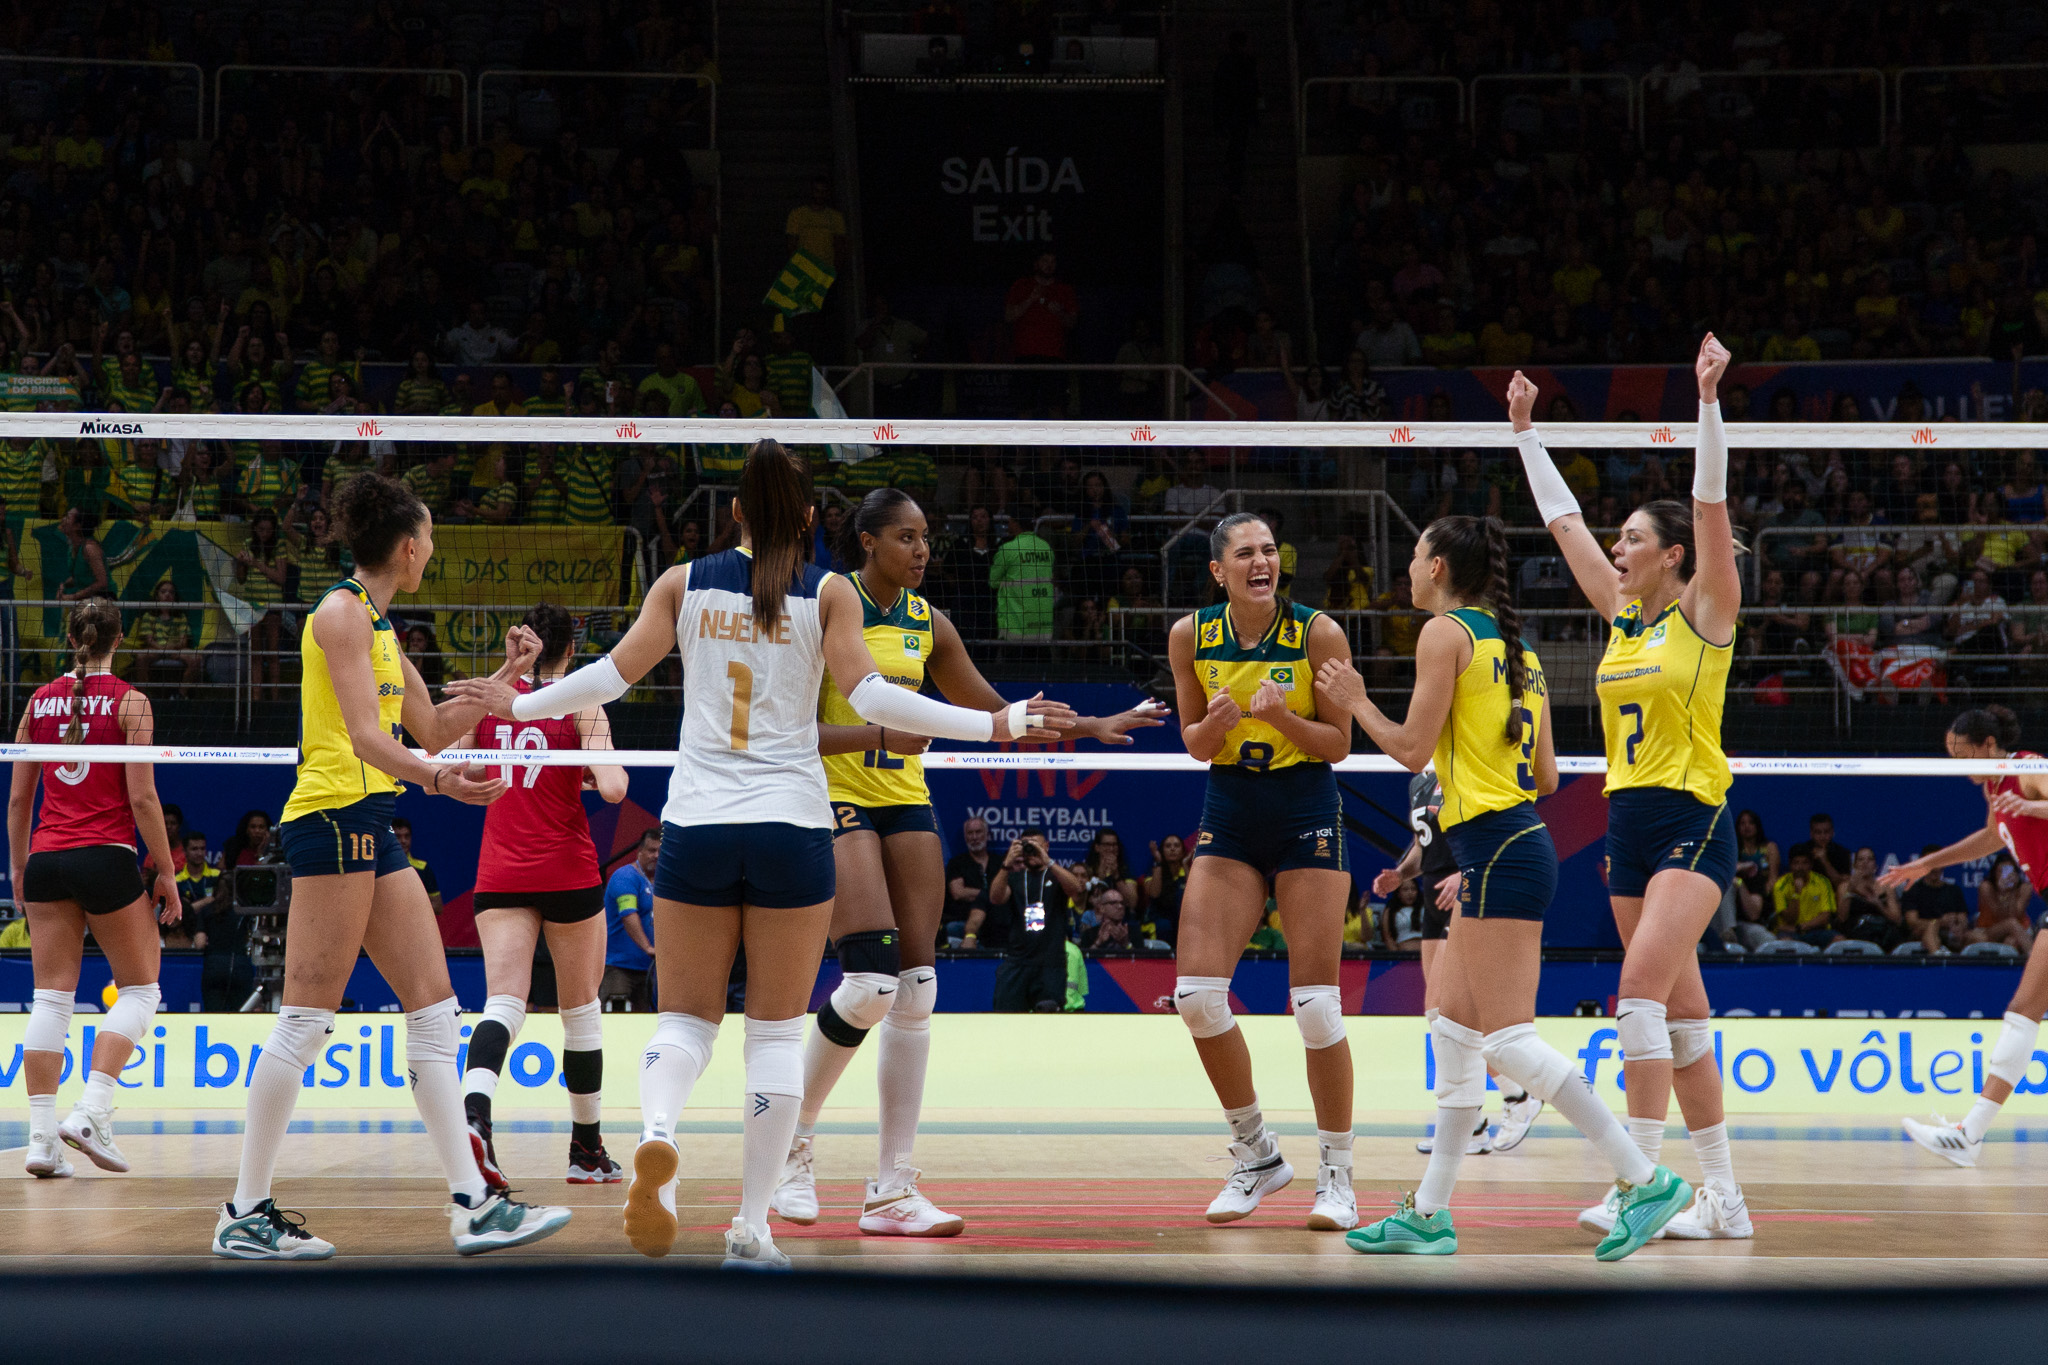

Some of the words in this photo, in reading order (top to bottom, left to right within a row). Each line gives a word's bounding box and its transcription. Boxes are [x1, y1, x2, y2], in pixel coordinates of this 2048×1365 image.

[941, 147, 1086, 194] SAÍDA
[972, 204, 1053, 242] Exit
[13, 377, 60, 385] TORCIDA
[13, 386, 29, 394] DO
[31, 386, 66, 395] BRASIL
[80, 418, 143, 434] MIKASA
[357, 420, 383, 436] VNL
[616, 422, 642, 438] VNL
[874, 423, 899, 440] VNL
[1131, 425, 1156, 442] VNL
[1390, 426, 1415, 443] VNL
[1651, 426, 1676, 443] VNL
[1911, 427, 1938, 444] VNL
[465, 558, 508, 584] DAS
[527, 557, 615, 585] CRUZES
[727, 660, 753, 751] 1
[1619, 703, 1644, 765] 7
[495, 724, 549, 789] 19
[966, 806, 1114, 827] VOLLEYBALL
[1412, 806, 1433, 847] 5
[1049, 830, 1096, 843] LEAG
[349, 832, 375, 860] 10
[1800, 1030, 1984, 1094] vôlei
